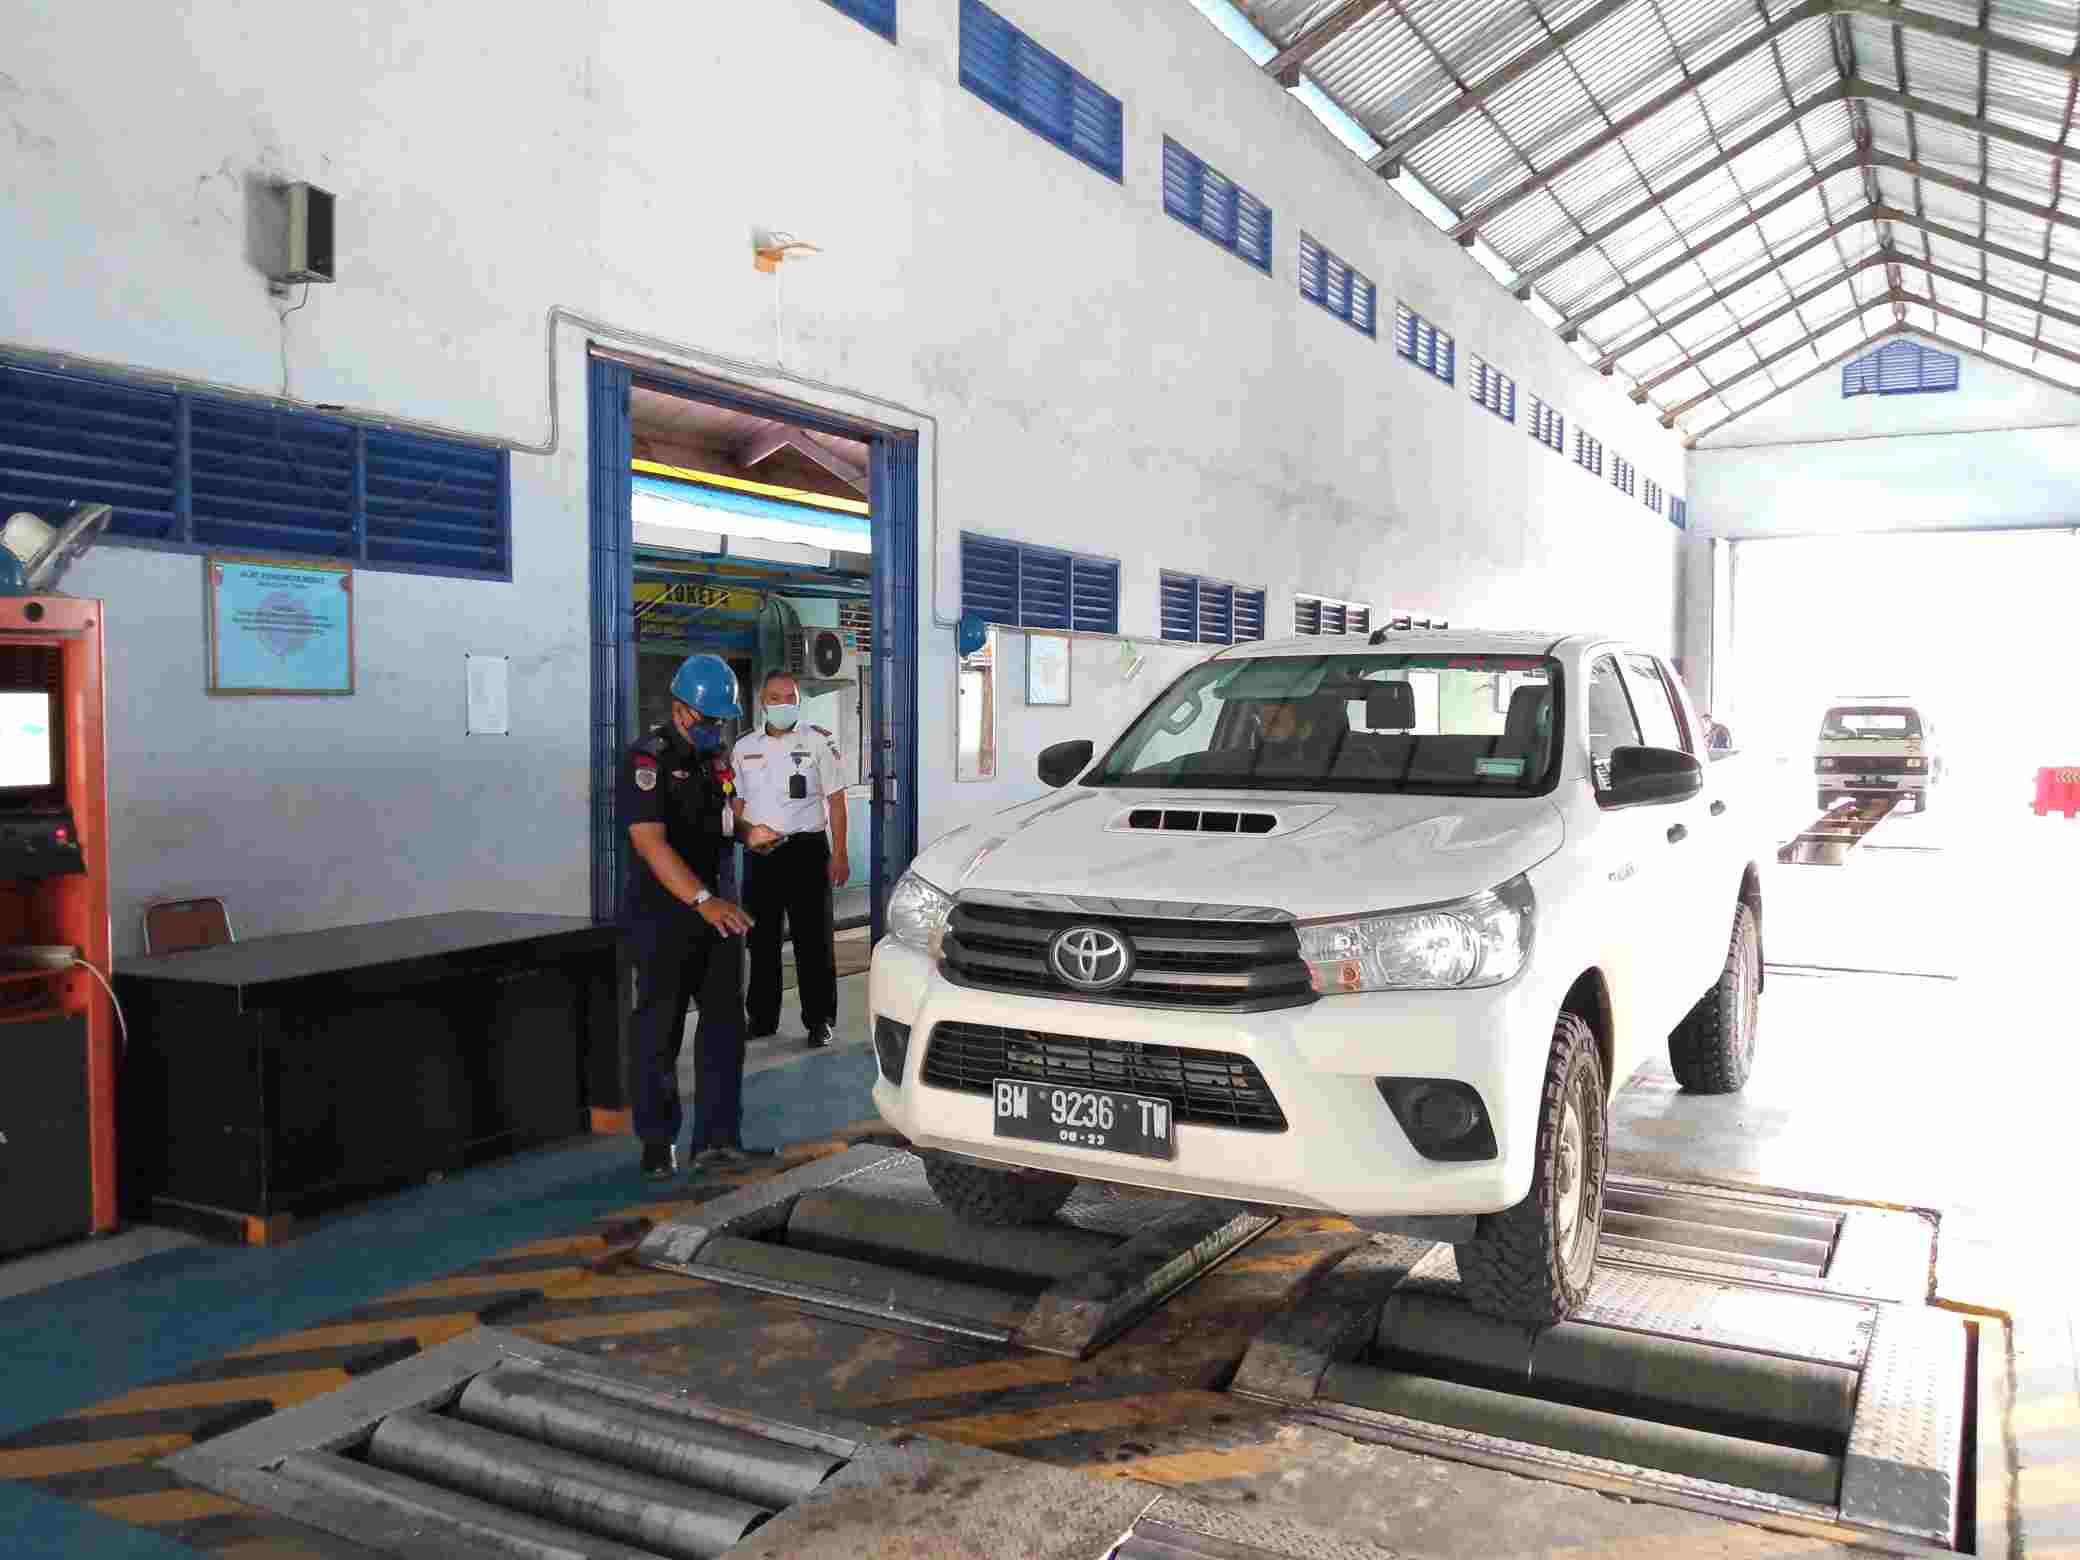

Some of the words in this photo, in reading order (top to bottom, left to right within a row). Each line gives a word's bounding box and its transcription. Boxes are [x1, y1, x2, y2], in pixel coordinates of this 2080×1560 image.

[998, 1083, 1028, 1119] BM
[1051, 1090, 1114, 1130] 9236
[1137, 1100, 1167, 1139] TW
